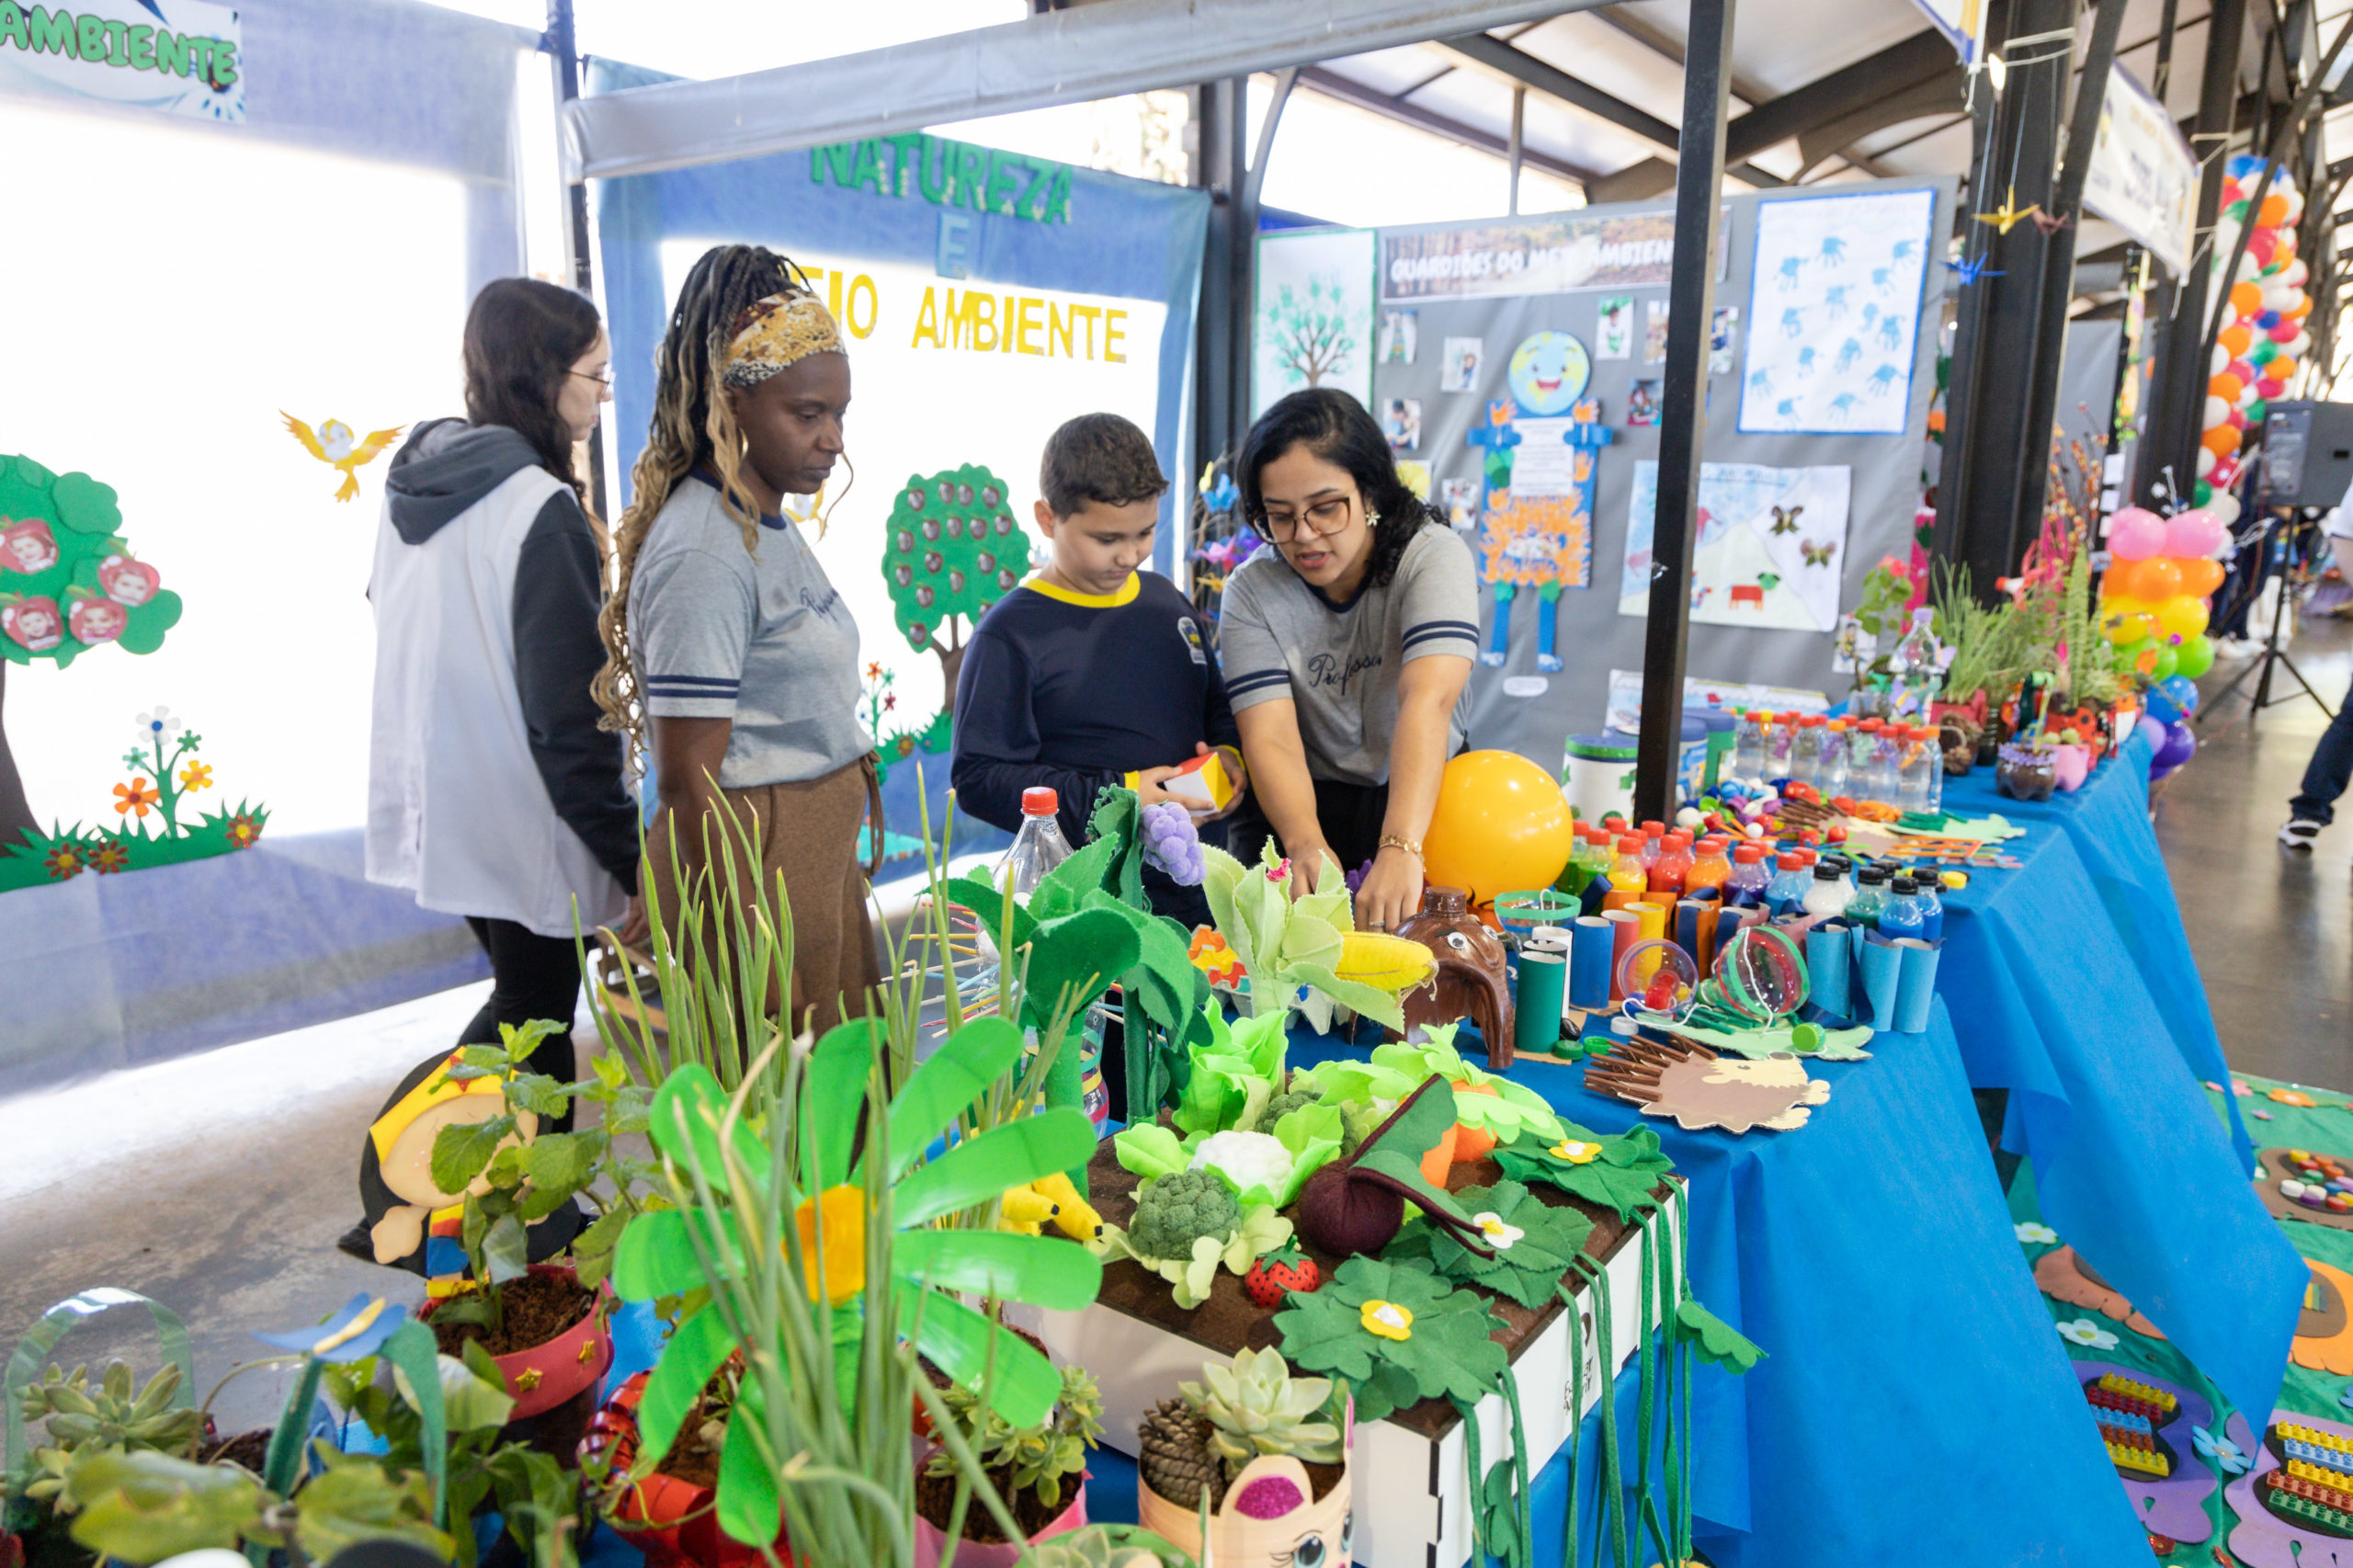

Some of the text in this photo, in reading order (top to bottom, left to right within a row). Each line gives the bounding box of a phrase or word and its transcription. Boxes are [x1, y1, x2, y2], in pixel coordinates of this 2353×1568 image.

[0, 0, 238, 85] AMBIENTE
[811, 131, 1074, 225] NATUREZA
[936, 211, 972, 279] E
[1496, 249, 1525, 275] DO
[1588, 239, 1674, 267] AMBIEN
[911, 286, 1128, 364] AMBIENTE
